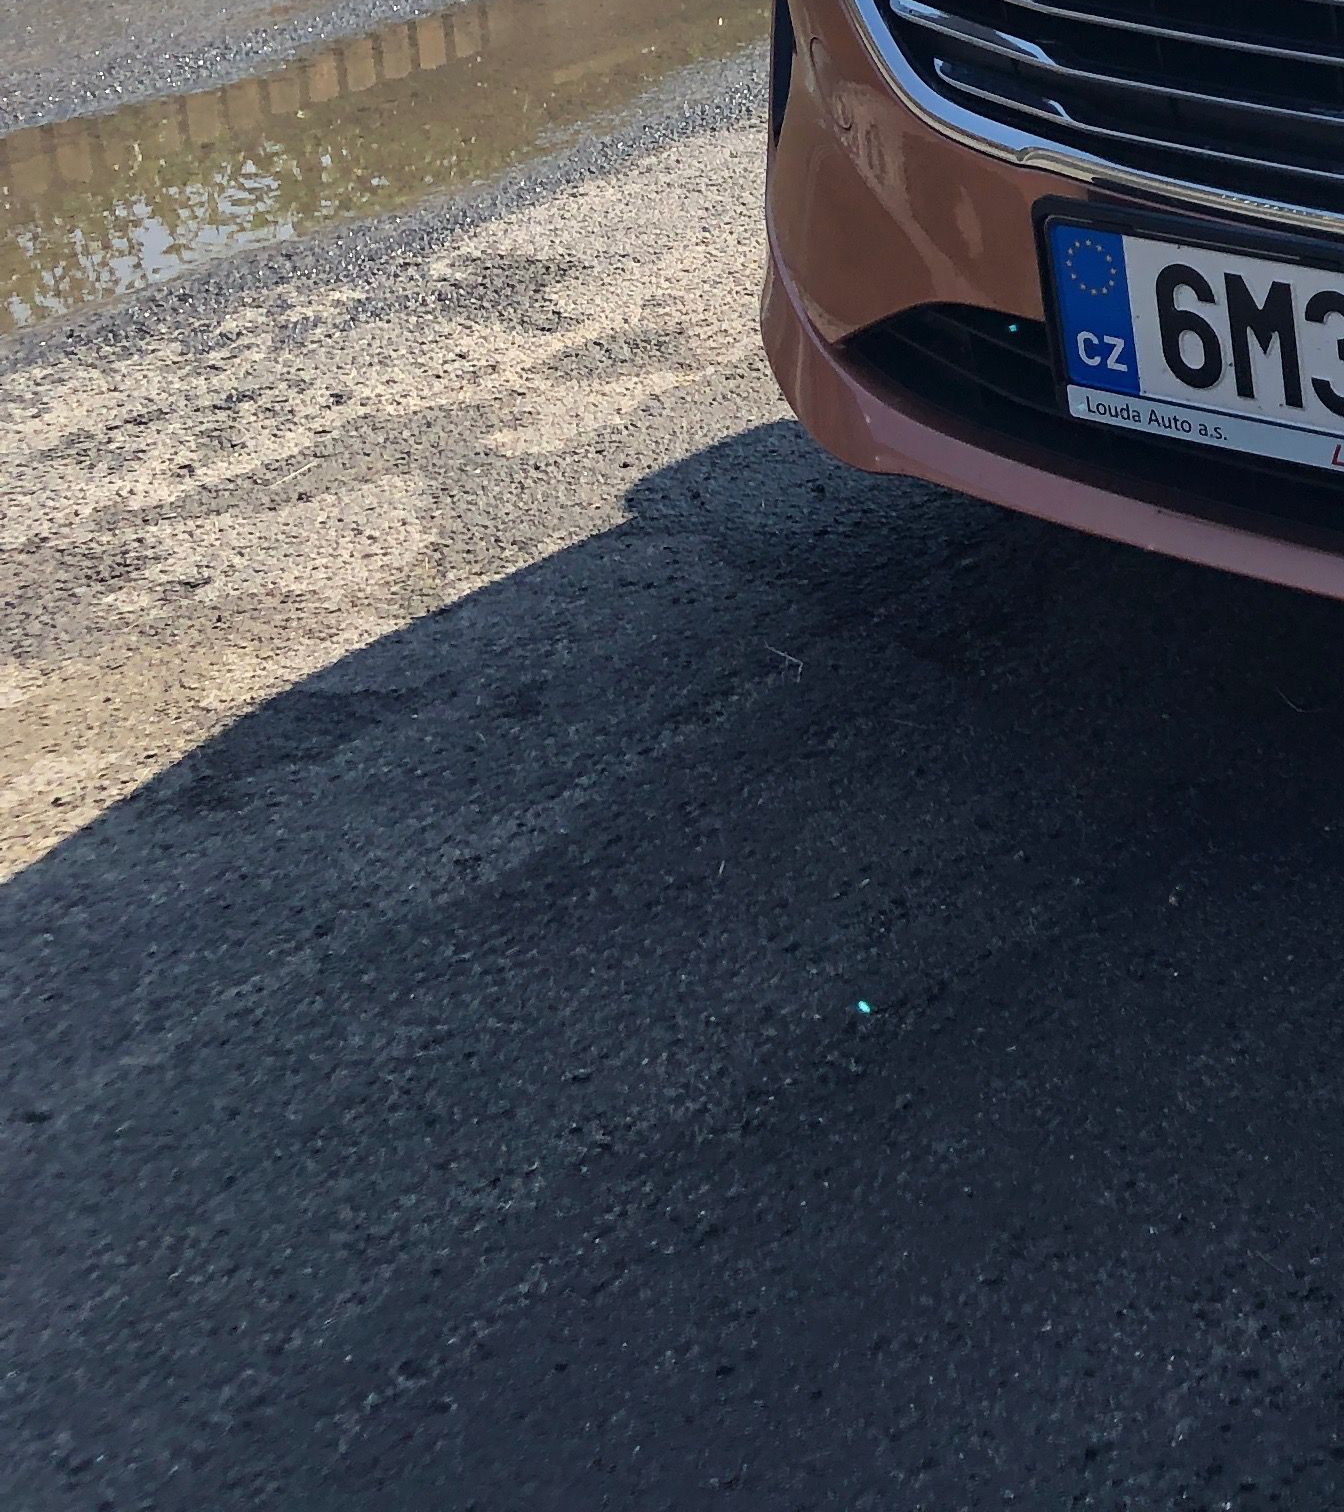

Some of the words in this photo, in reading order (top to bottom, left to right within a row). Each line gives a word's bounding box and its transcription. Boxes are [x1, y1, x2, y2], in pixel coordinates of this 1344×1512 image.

[1076, 330, 1128, 372] CZ
[1085, 395, 1142, 424] Louda
[1147, 408, 1193, 434] Auto
[1197, 422, 1228, 441] a.s.
